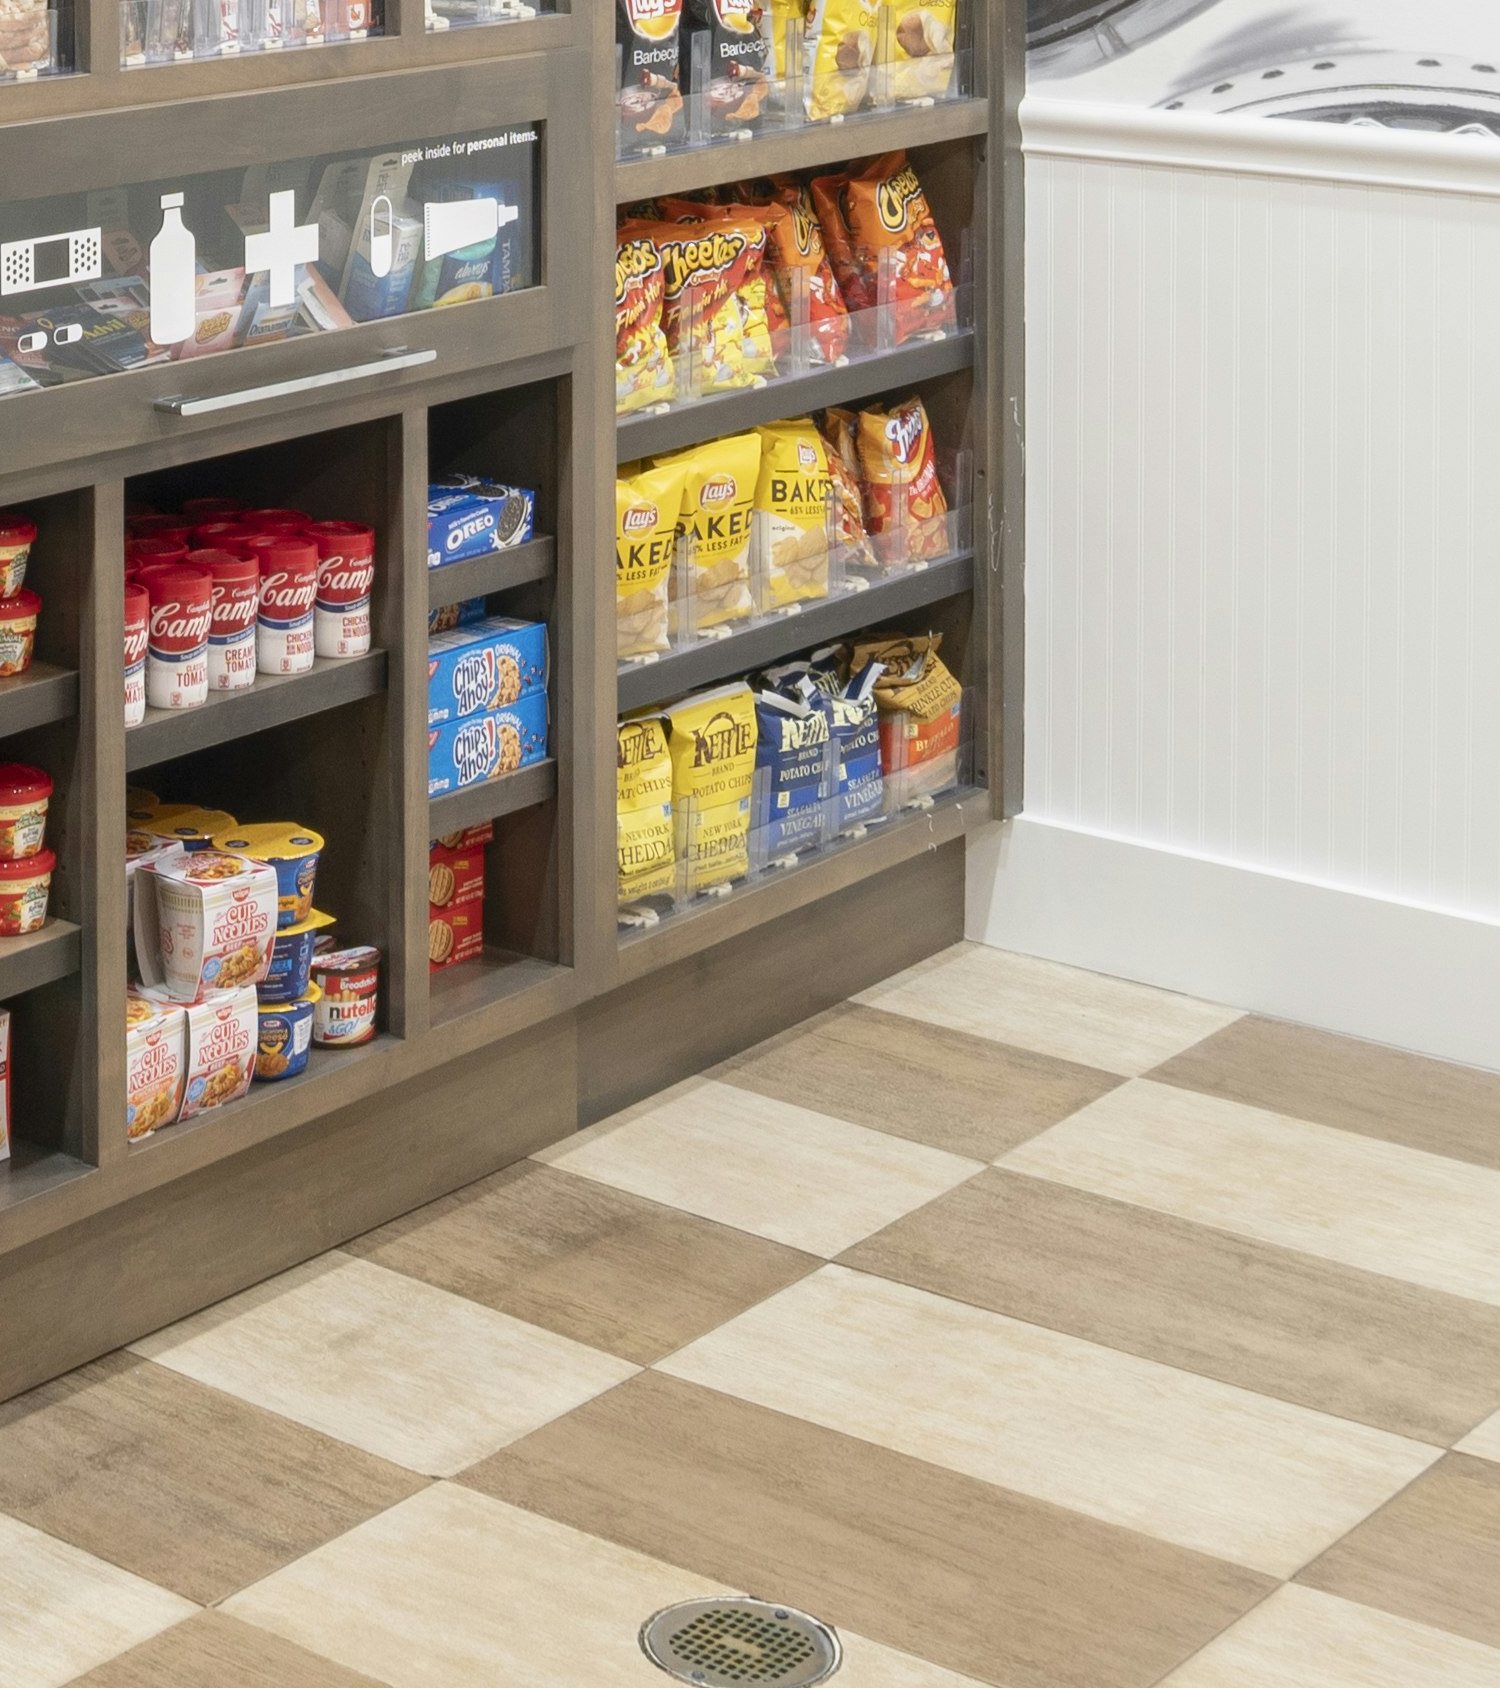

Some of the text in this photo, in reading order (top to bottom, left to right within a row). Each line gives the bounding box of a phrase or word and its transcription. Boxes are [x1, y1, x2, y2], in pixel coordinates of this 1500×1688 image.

[402, 129, 538, 166] peek inside for personal items.
[454, 260, 491, 280] always
[699, 479, 736, 504] Lay's
[623, 504, 658, 530] Lay's
[447, 514, 494, 551] OREO
[454, 656, 487, 697] Chips
[454, 725, 487, 767] Chips
[690, 711, 755, 769] KETTLE
[636, 775, 672, 797] CHIPS
[691, 773, 752, 799] POTATO CHIPS
[844, 782, 884, 809] VINEGAR
[687, 831, 748, 862] CHEDDA
[226, 900, 258, 925] CUP
[212, 913, 268, 946] NOODLES
[210, 1018, 240, 1043] CUP
[140, 1042, 169, 1071] CUP
[197, 1030, 249, 1066] NOODLES
[128, 1054, 178, 1094] NOODLES
